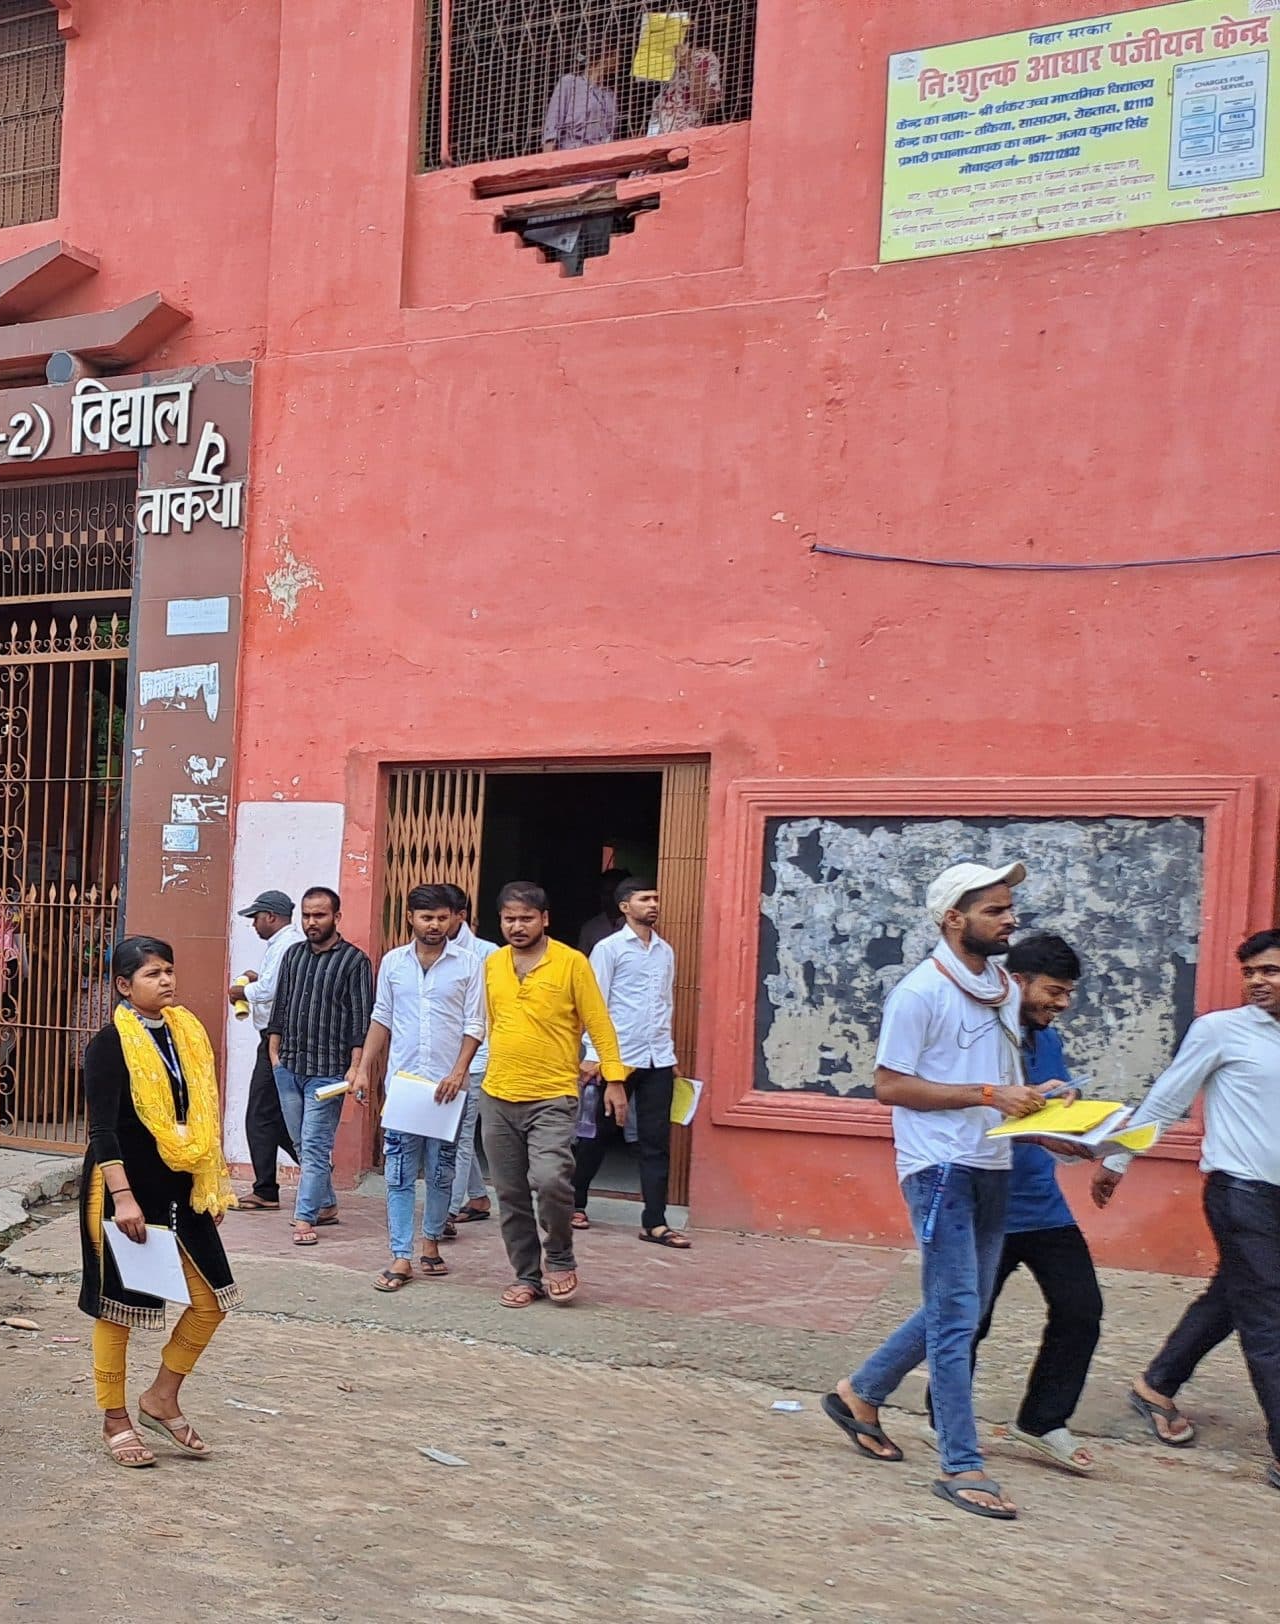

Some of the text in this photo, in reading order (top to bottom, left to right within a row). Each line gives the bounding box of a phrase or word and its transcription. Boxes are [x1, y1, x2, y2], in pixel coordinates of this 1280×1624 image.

[1028, 22, 1112, 46] बिहार सरकार
[1025, 45, 1104, 83] आधार
[1108, 28, 1206, 67] पंजीयन
[1210, 15, 1271, 50] केन्द्र
[1194, 75, 1245, 88] CHARGES FOR
[923, 115, 941, 126] का
[978, 103, 994, 117] श्री
[994, 100, 1026, 114] शंकर
[1050, 86, 1106, 104] माध्यमिक
[1107, 78, 1155, 95] विद्यालय
[922, 133, 939, 144] का
[1003, 138, 1021, 149] का
[1089, 121, 1124, 138] कुमार
[1124, 115, 1150, 130] सिंह
